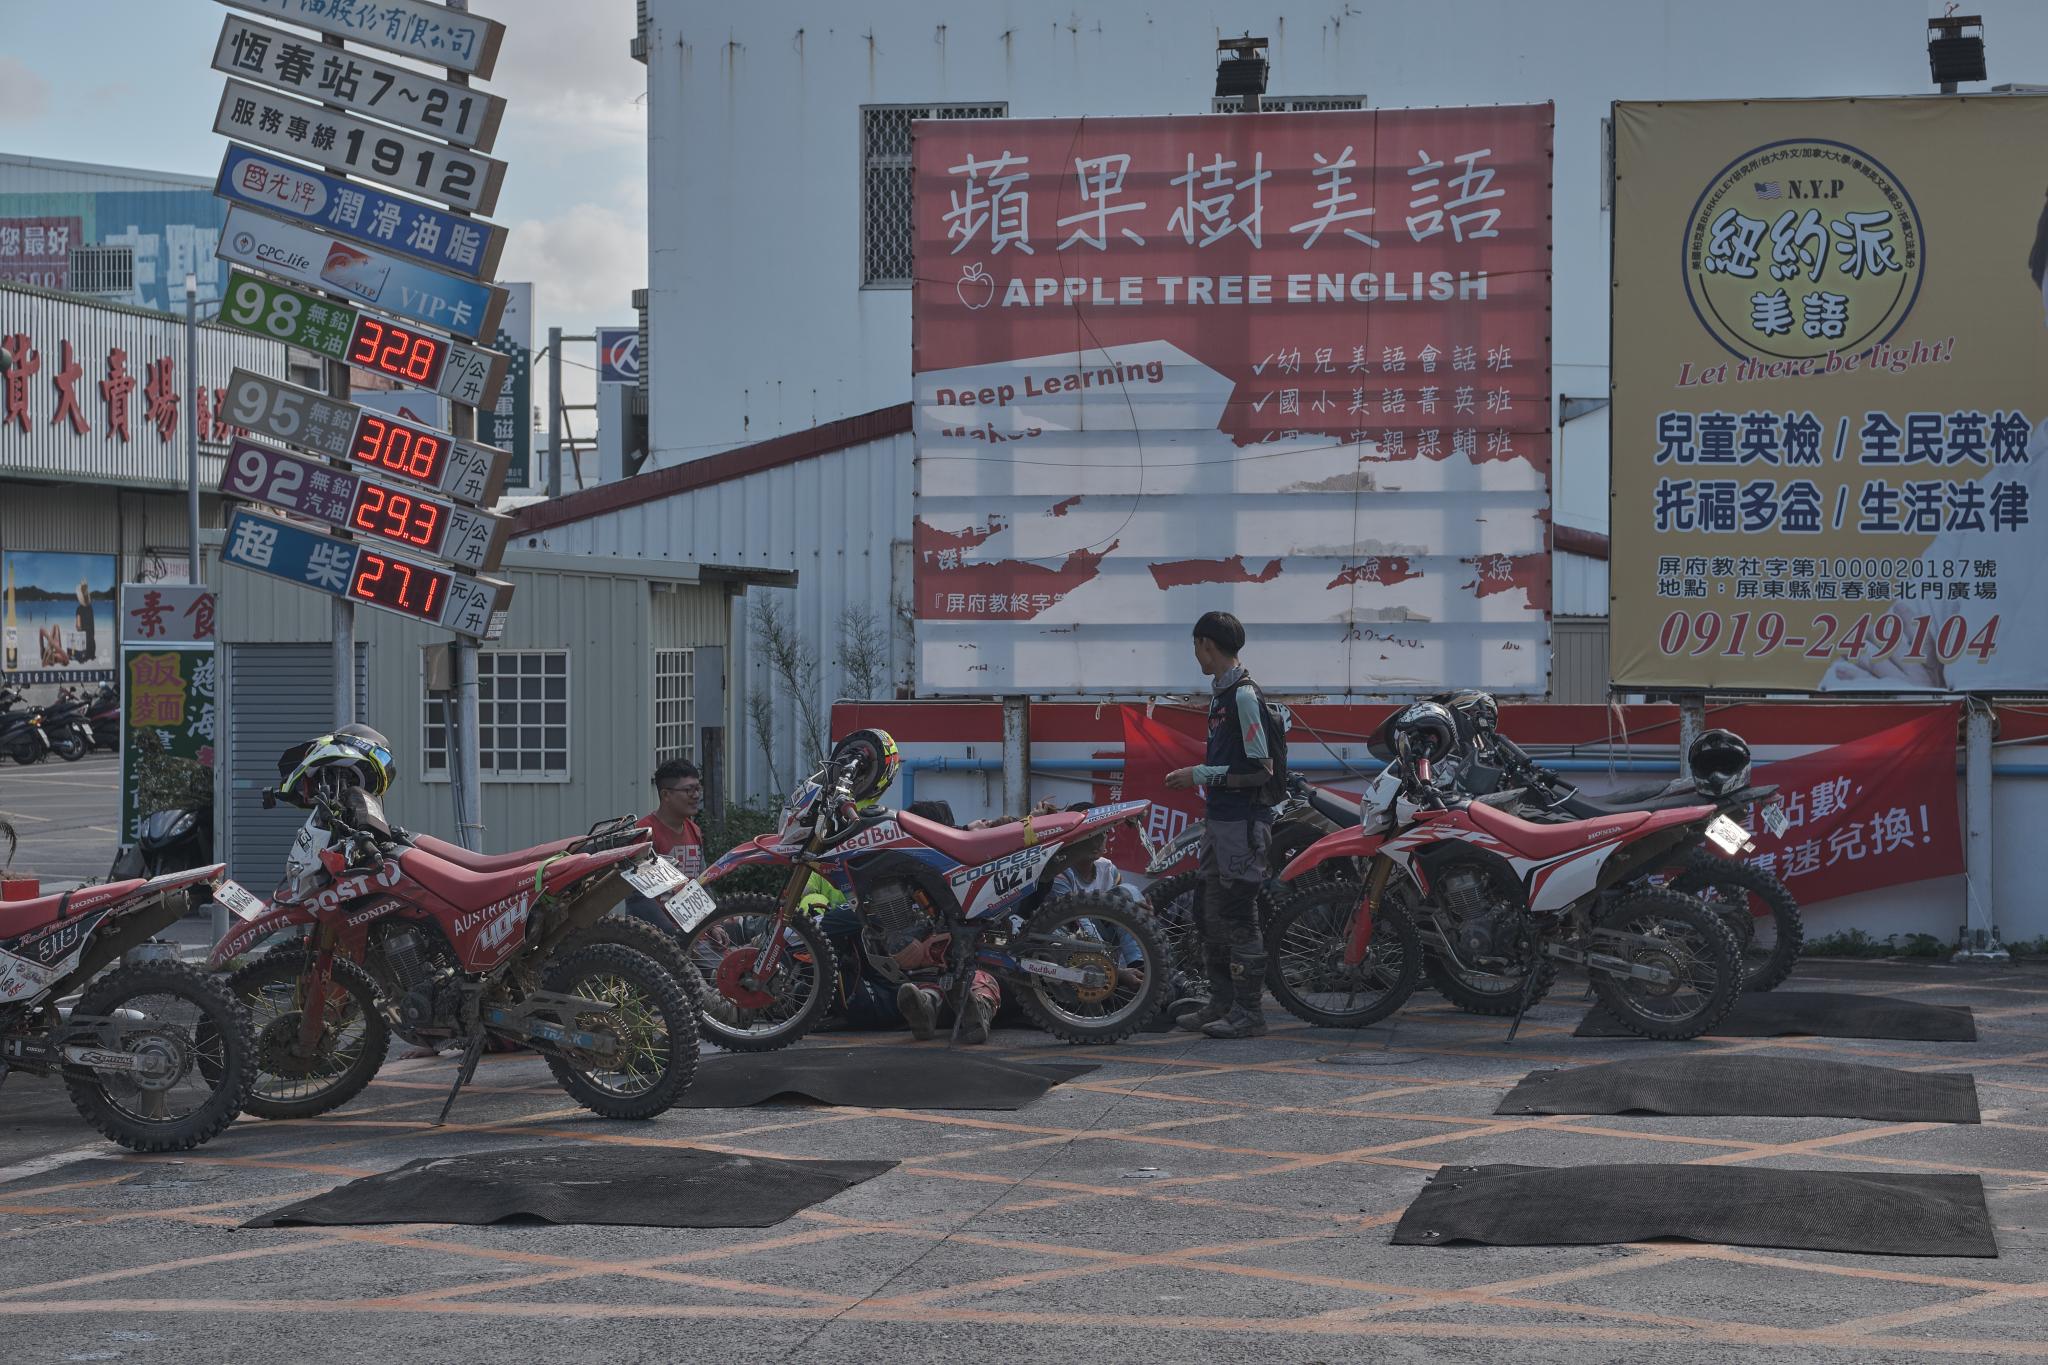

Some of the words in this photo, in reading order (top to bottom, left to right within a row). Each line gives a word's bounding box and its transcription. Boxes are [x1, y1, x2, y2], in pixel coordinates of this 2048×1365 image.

[942, 145, 1505, 254] 蘋果樹美語
[1788, 179, 1845, 199] N.Y.P
[0, 226, 69, 256] 您最好
[328, 187, 481, 266] 潤滑油脂
[257, 243, 310, 269] CPC.life
[1704, 207, 1901, 282] 紐約派
[355, 281, 376, 297] VIP
[1002, 277, 1144, 307] APPLE
[1157, 275, 1274, 305] TREE
[1295, 271, 1488, 301] ENGLISH
[231, 281, 301, 337] 98
[308, 303, 350, 333] 無鉛
[1751, 289, 1849, 338] 美語
[301, 326, 343, 354] 汽油
[1277, 344, 1513, 374] 幼兒美語會話班
[1677, 361, 1728, 388] Let
[1736, 356, 1816, 381] there
[1825, 350, 1861, 373] be
[1871, 336, 1956, 375] light!
[936, 384, 1015, 407] Deep
[1025, 360, 1165, 398] Learning
[233, 381, 304, 435] 95
[309, 402, 351, 431] 無鉛
[1278, 385, 1513, 416] 國小美語菁英班
[302, 426, 346, 454] 汽油
[1656, 412, 1822, 465] 兒童英檢
[1860, 411, 2030, 464] 全民英檢
[233, 450, 304, 507] 92
[309, 471, 351, 498] 無鉛
[302, 493, 346, 521] 汽油
[1655, 480, 1822, 532] 托福多益
[1860, 481, 2029, 533] 生活法律
[231, 520, 350, 590] 超柴
[1657, 557, 1997, 578] 屏府教社字第1000020187號
[131, 591, 215, 639] 素食
[1660, 610, 2001, 660] 0919-249104
[132, 654, 185, 725] 飯麵
[871, 822, 905, 843] Bul
[1036, 825, 1064, 838] ONDA
[1588, 826, 1622, 840] HONDA
[951, 845, 1041, 887] COOPER
[998, 856, 1040, 878] TIRES
[70, 893, 112, 910] HONDA
[349, 900, 400, 926] HONDA
[218, 914, 292, 963] AUSTRALIA
[480, 900, 528, 951] 404
